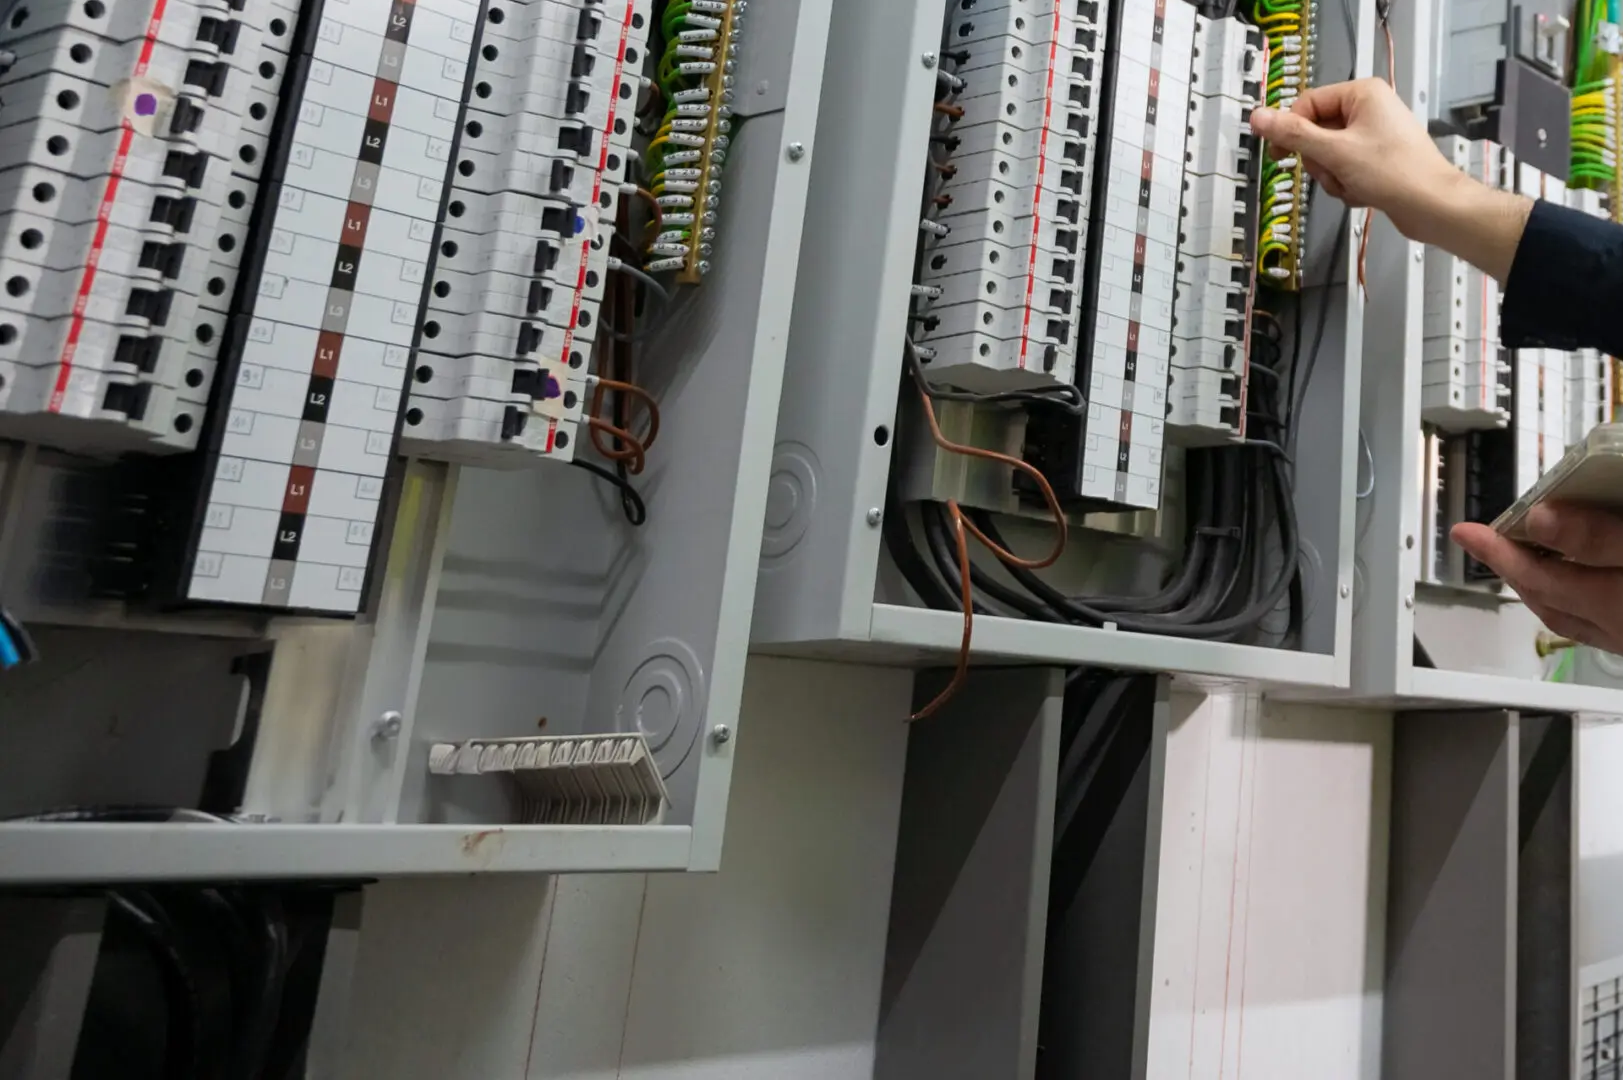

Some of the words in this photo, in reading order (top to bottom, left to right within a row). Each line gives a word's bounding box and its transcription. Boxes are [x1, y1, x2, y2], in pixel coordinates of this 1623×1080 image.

[393, 15, 406, 27] L2
[384, 55, 398, 67] L3
[375, 94, 388, 107] L1
[367, 136, 380, 148] L2
[357, 177, 371, 189] L3
[348, 219, 361, 231] L1
[339, 261, 354, 273] L2
[329, 304, 344, 317] L3
[320, 348, 334, 360] L1
[310, 393, 325, 405] L2
[300, 438, 316, 450] L3
[290, 484, 304, 496] L1
[280, 530, 296, 543] L2
[270, 578, 286, 590] L3
